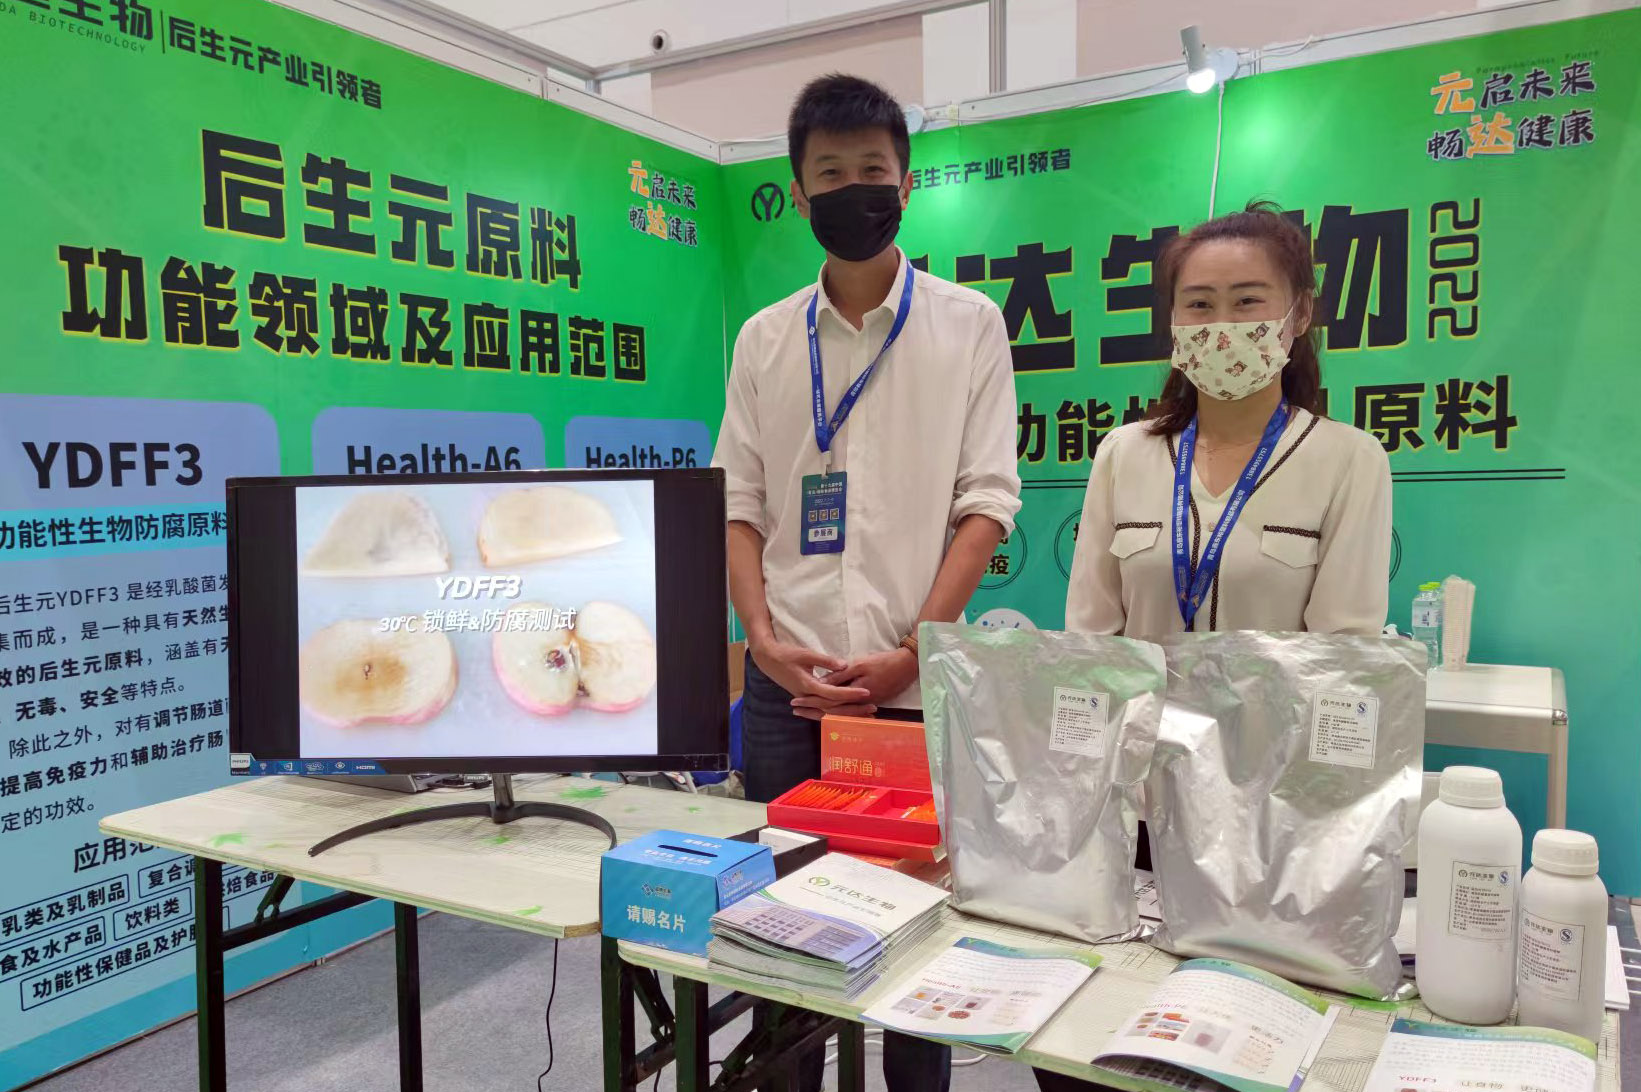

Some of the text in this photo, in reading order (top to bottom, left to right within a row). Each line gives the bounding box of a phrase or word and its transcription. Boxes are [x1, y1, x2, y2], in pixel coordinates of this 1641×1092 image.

[19, 0, 153, 41] 生物
[29, 11, 147, 54] BIOTECHNOLOGY
[168, 16, 382, 109] 后生元产业引领者
[1431, 62, 1596, 115] 元启未来
[1427, 111, 1594, 160] 畅达健康
[628, 160, 697, 211] 元启未来
[202, 129, 581, 289] 后生元原料
[629, 200, 698, 247] 畅达健康
[911, 205, 1409, 372] 达生物
[1428, 198, 1481, 340] 2022
[58, 245, 647, 382] 功能领域及应用范围
[1319, 375, 1517, 452] 原料
[22, 442, 203, 488] YDFF3
[347, 443, 521, 474] Health-A6
[586, 445, 697, 468] Health-P6
[0, 510, 228, 550] 功能性生物防腐原料
[435, 575, 523, 600] YDFF3
[421, 607, 577, 633] 锁鲜&防腐测试
[9, 698, 228, 760] 除此之外，对有调节肠道
[1, 796, 95, 833] 定的功效。
[73, 836, 160, 873] 应用
[221, 870, 275, 897] 焙食品
[2, 881, 125, 937] 乳类及乳制品
[125, 897, 180, 931] 饮料类
[626, 904, 686, 933] 请赐名片
